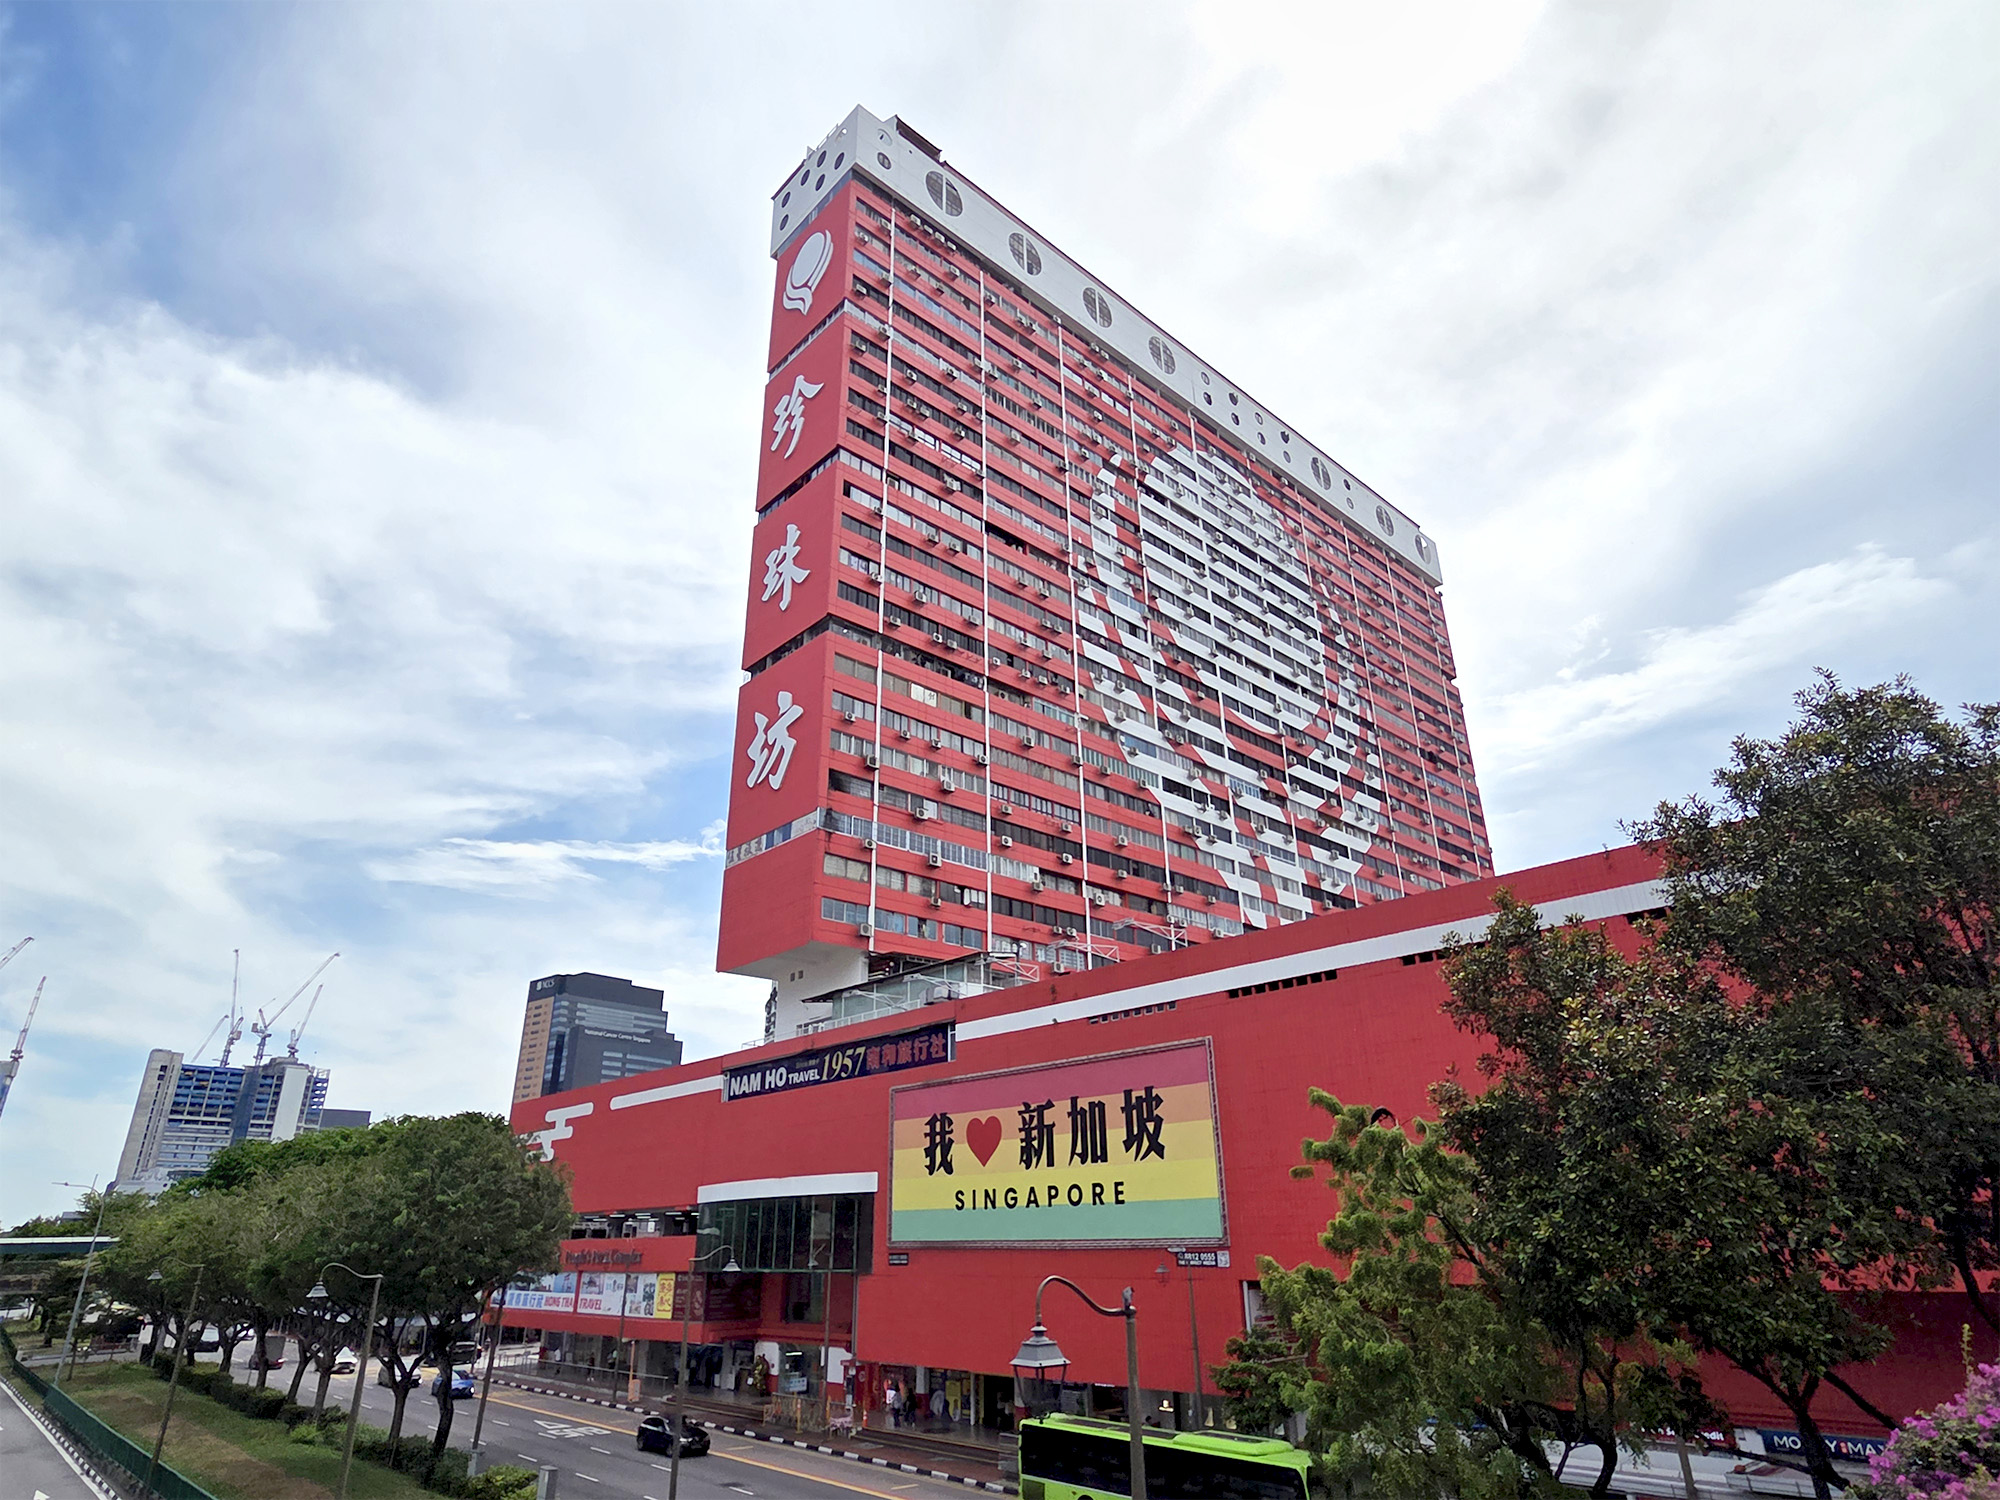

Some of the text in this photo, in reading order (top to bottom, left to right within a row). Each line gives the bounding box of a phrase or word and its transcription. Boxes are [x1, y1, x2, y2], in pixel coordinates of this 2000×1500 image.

[746, 375, 824, 790] 珍珠坊
[730, 1072, 761, 1096] NAM
[765, 1066, 787, 1090] HO
[788, 1068, 820, 1085] TRAVEL
[821, 1046, 866, 1081] 1957
[923, 1085, 1166, 1176] 我 新加坡
[955, 1181, 1126, 1211] SINGAPORE
[1773, 1435, 1837, 1453] MOY
